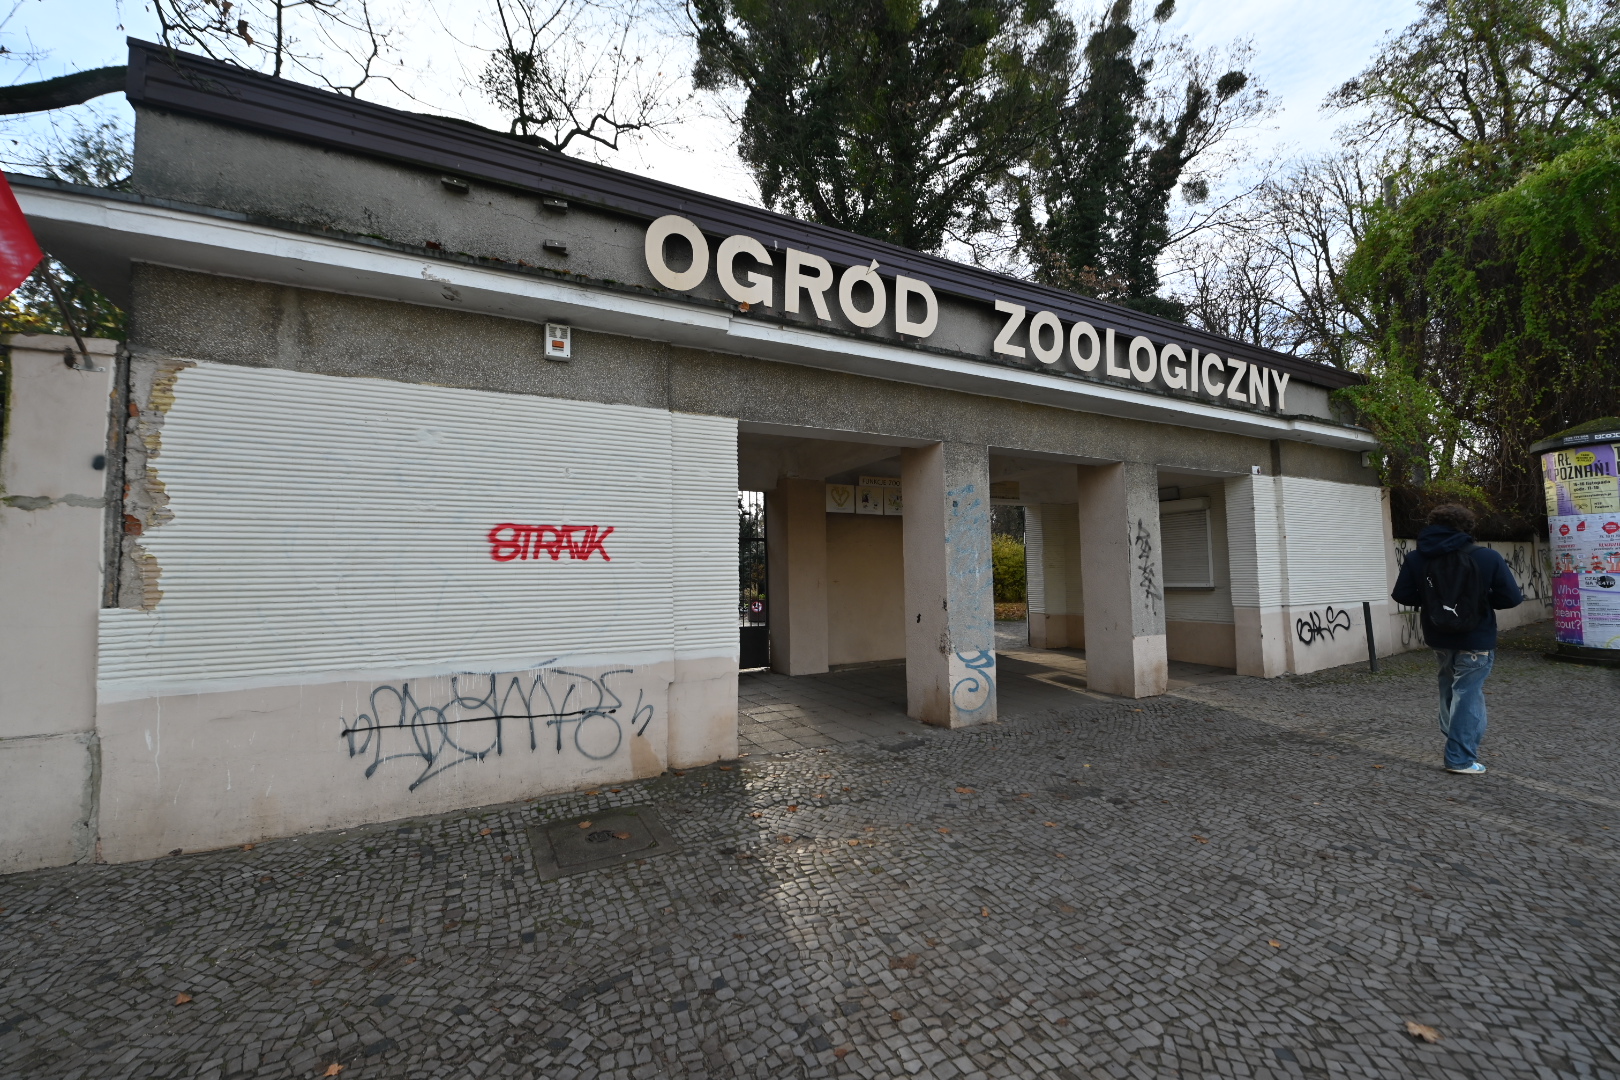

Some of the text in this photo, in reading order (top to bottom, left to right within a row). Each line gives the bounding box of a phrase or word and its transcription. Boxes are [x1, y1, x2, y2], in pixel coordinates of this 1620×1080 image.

[644, 214, 1290, 411] OGRÓD ZOOLOGICZNY
[1554, 460, 1610, 481] POZNAŃ!
[1557, 585, 1580, 595] Who
[1562, 598, 1580, 607] you
[1555, 607, 1580, 618] dream
[1555, 618, 1581, 630] about?
